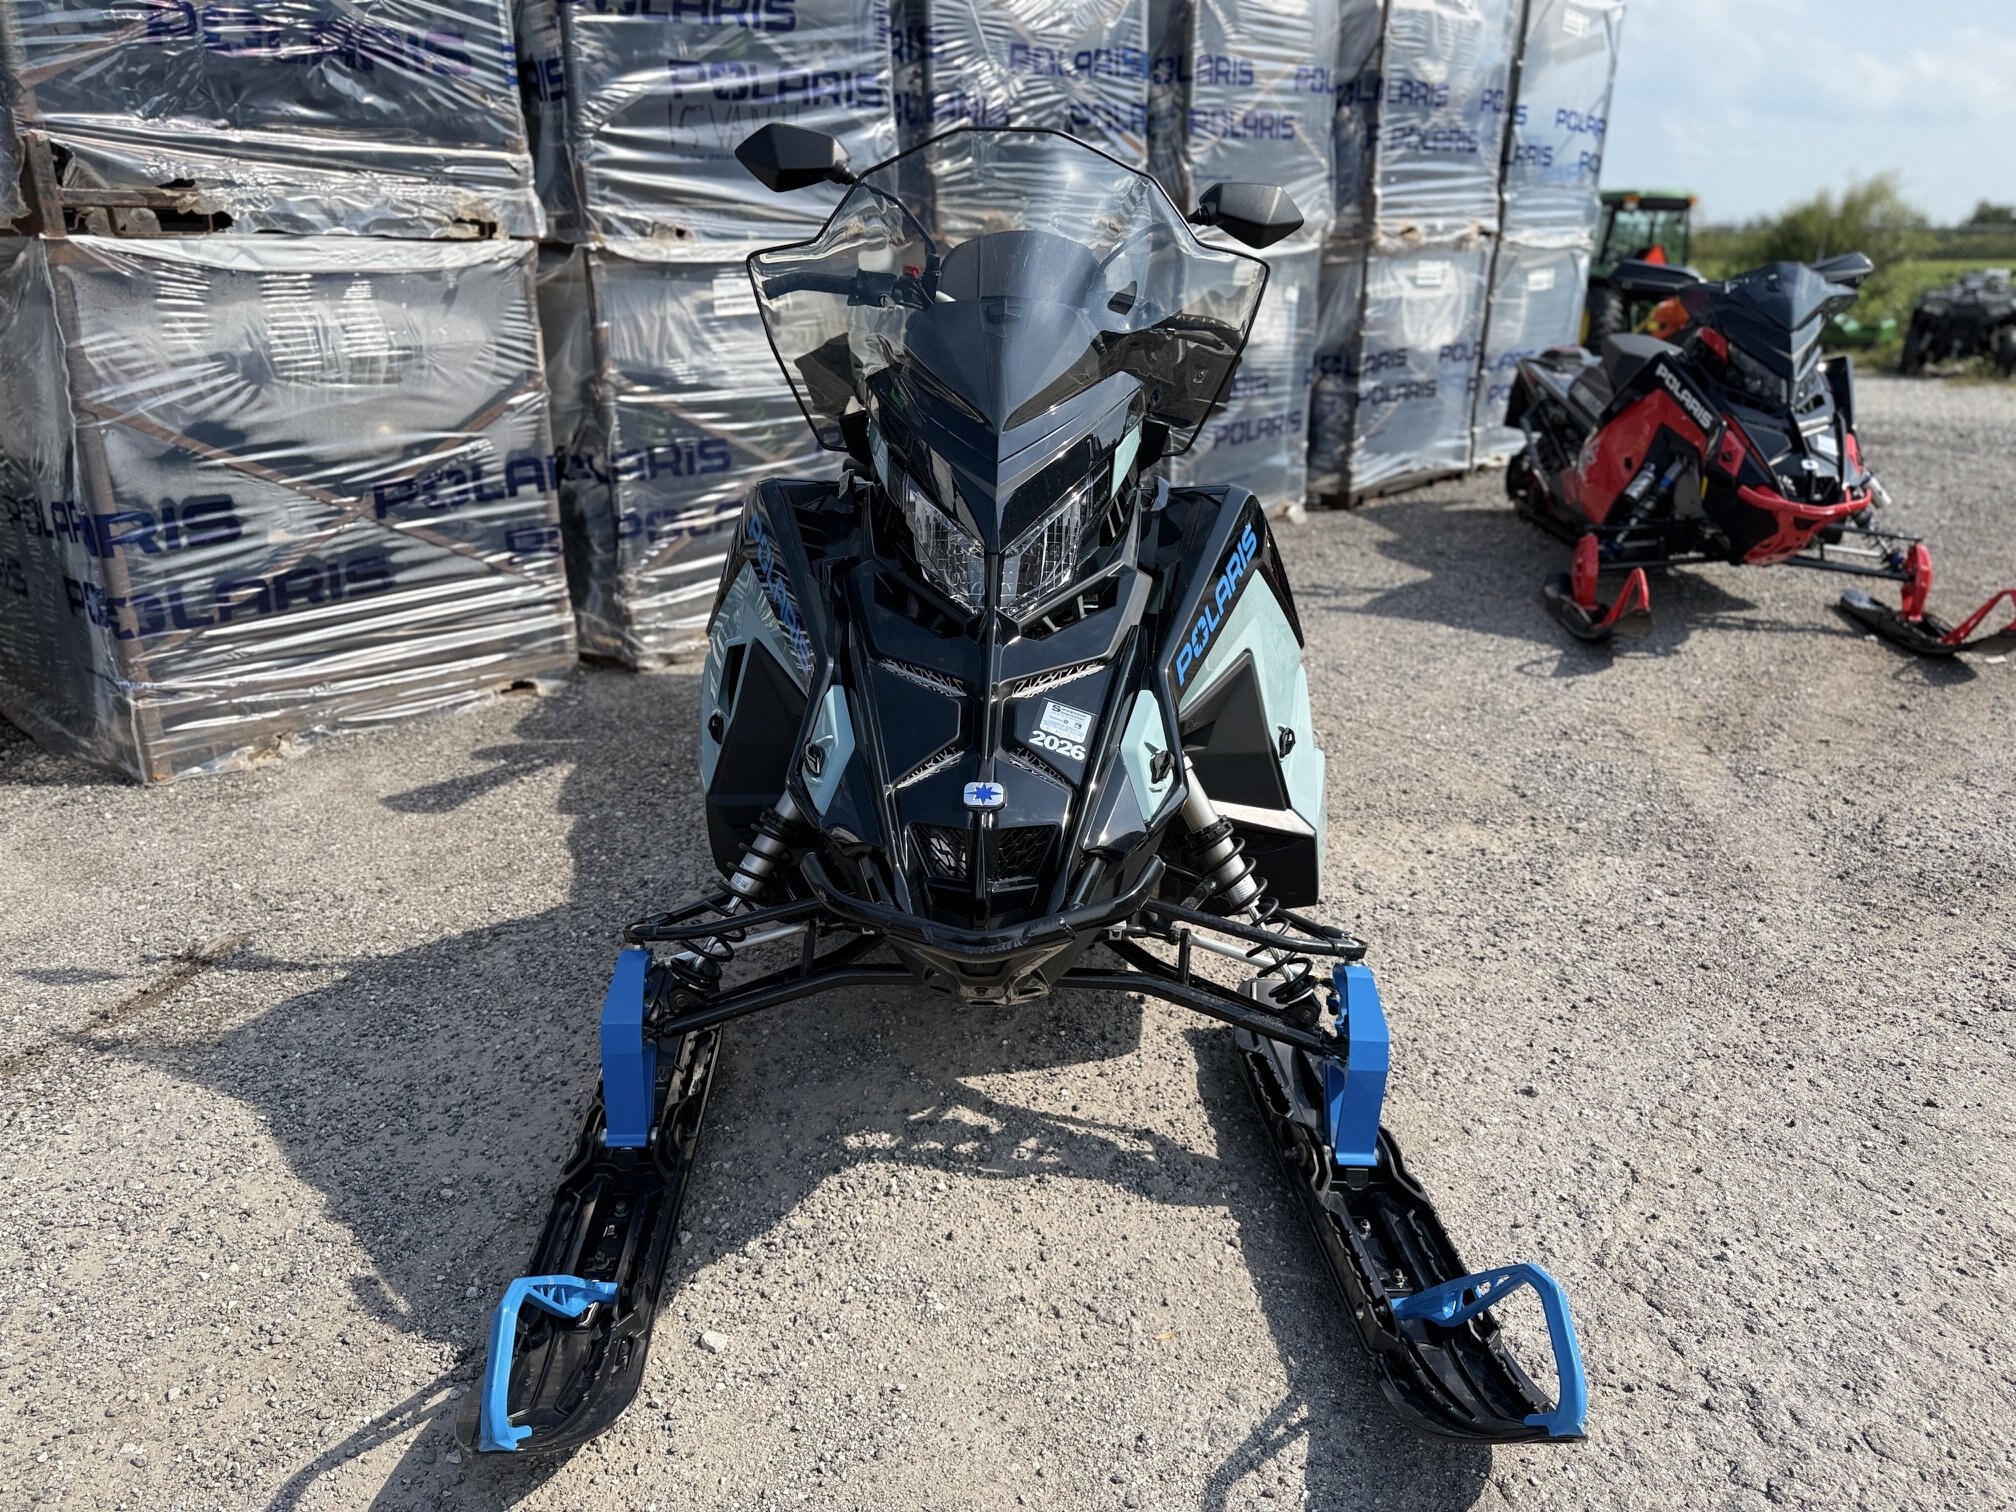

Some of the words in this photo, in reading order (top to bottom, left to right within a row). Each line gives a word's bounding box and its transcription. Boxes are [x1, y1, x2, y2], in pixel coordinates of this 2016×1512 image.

[596, 0, 797, 32] OLARIS
[668, 59, 886, 107] POLARIS
[1655, 363, 1714, 429] POLARIS
[1214, 410, 1303, 450] POLARIS
[1176, 523, 1258, 687] POLARIS
[1029, 730, 1086, 761] 2026
